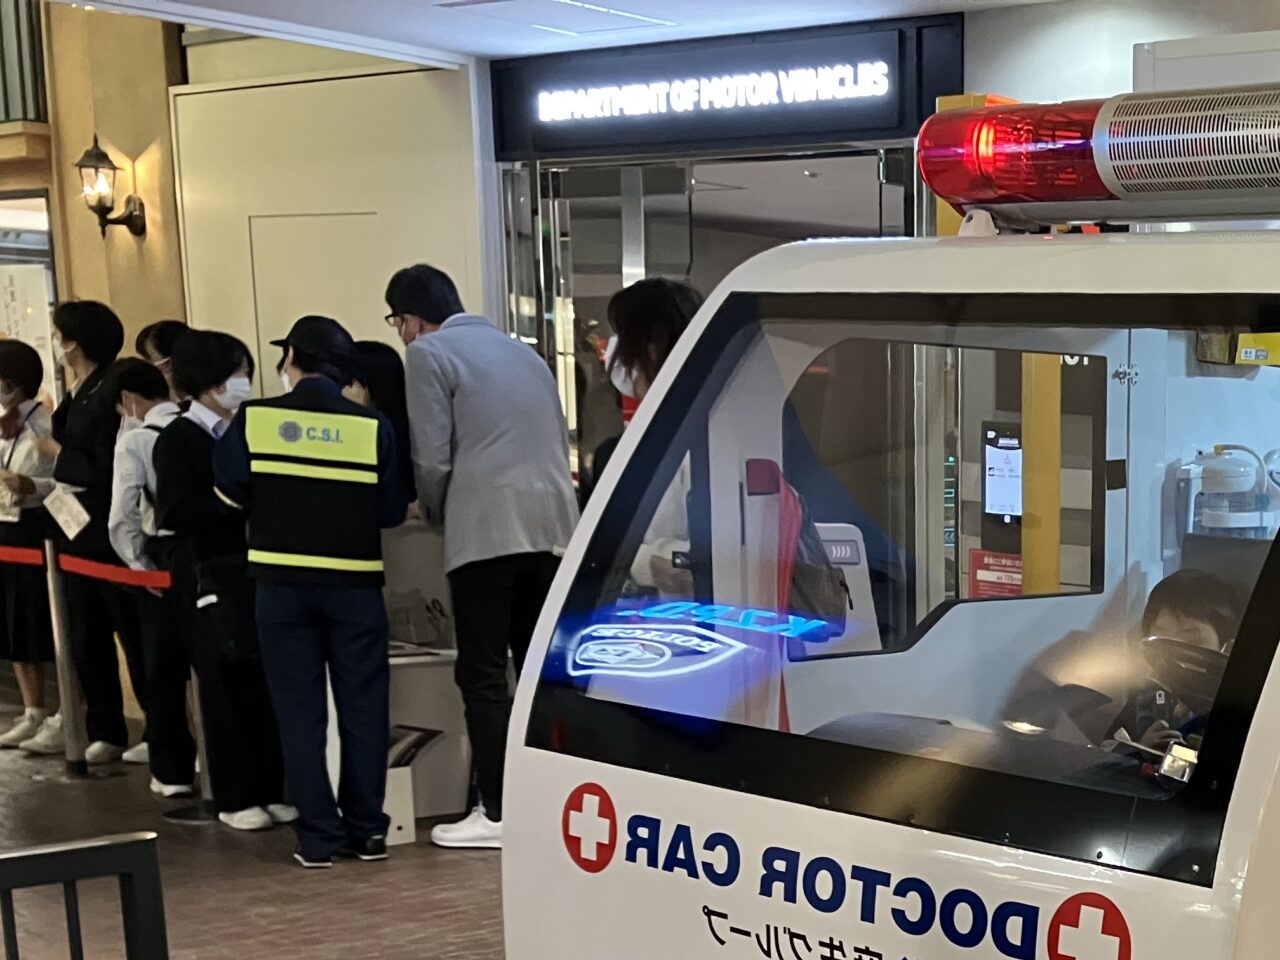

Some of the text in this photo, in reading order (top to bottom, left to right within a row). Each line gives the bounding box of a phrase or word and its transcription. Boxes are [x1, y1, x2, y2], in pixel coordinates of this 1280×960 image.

[537, 61, 889, 121] DEPARTMENT OF MOTOR VEHICLES
[306, 427, 344, 443] C.S.I.
